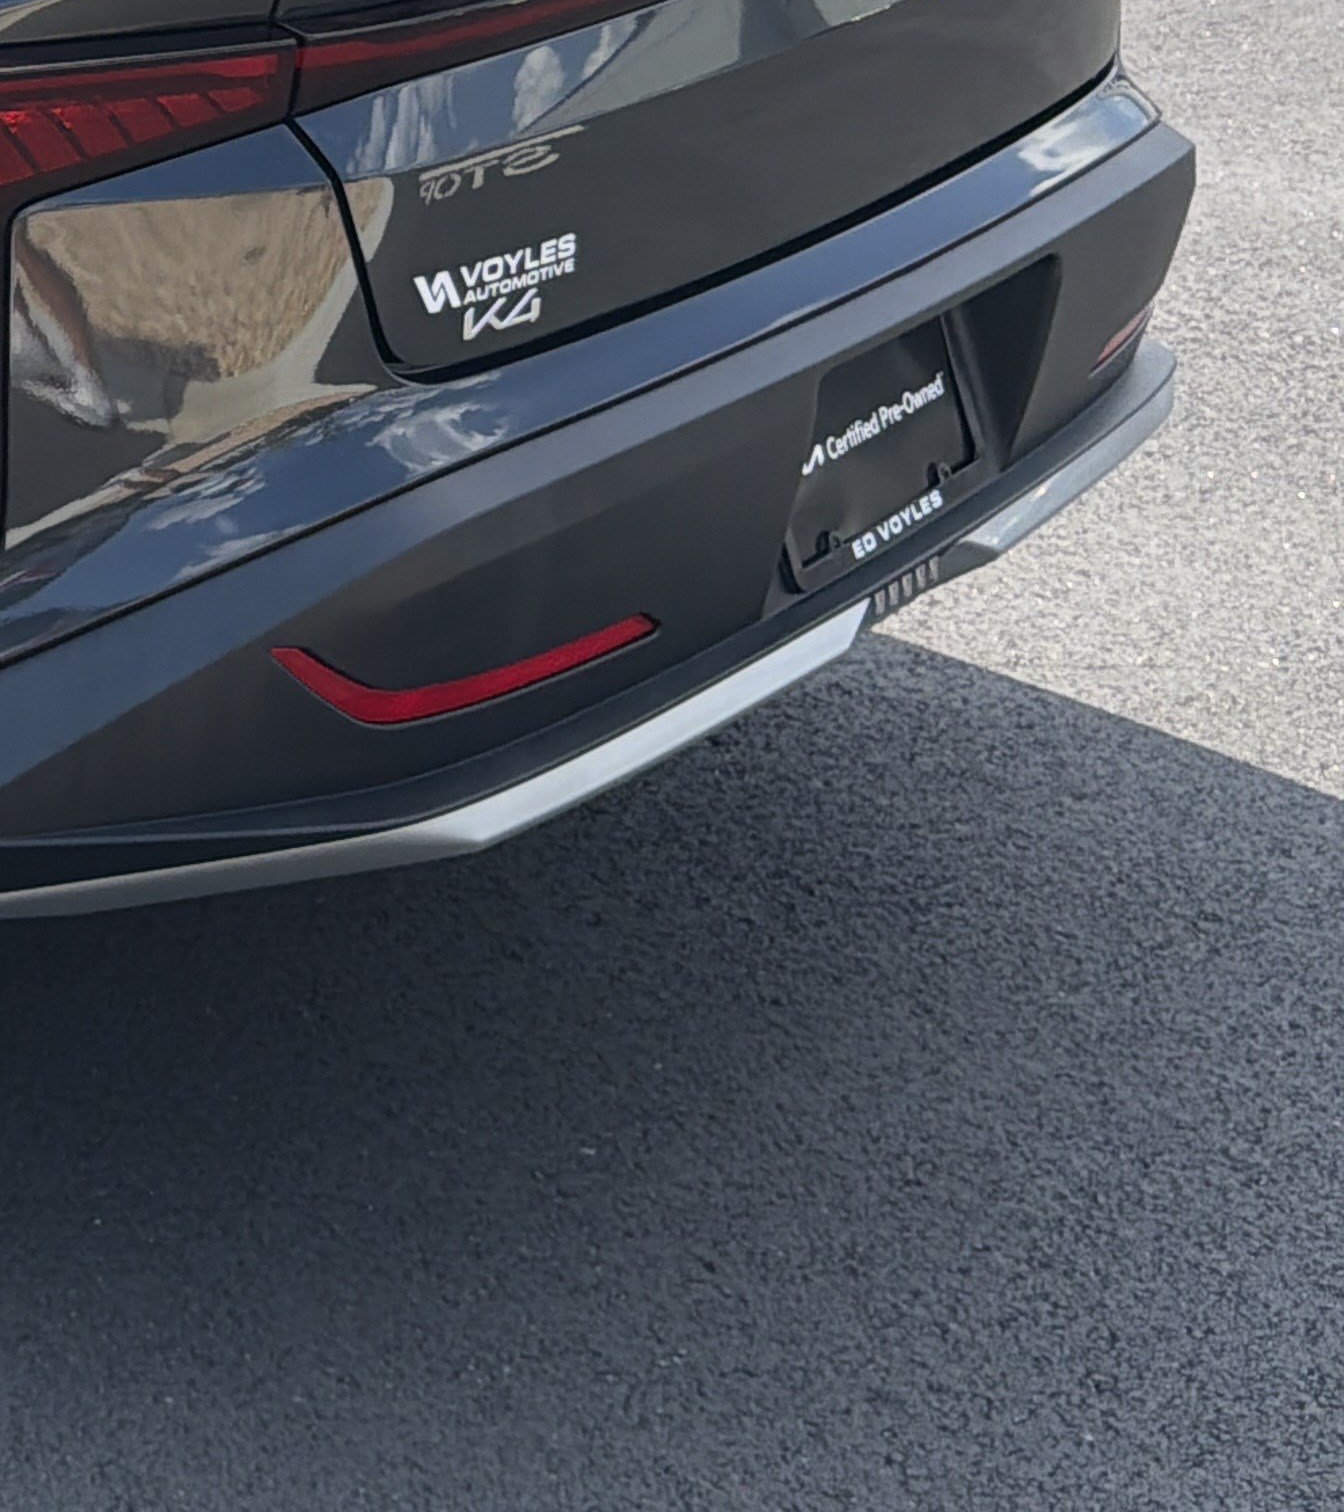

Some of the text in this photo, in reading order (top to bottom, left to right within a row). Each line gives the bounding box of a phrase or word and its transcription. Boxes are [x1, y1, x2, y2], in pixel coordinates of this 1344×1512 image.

[460, 232, 577, 287] VOYLES
[463, 258, 576, 305] AUTOMOTIVE
[463, 288, 542, 341] K4
[826, 412, 881, 460] Certified
[851, 489, 944, 560] ED VOYLES
